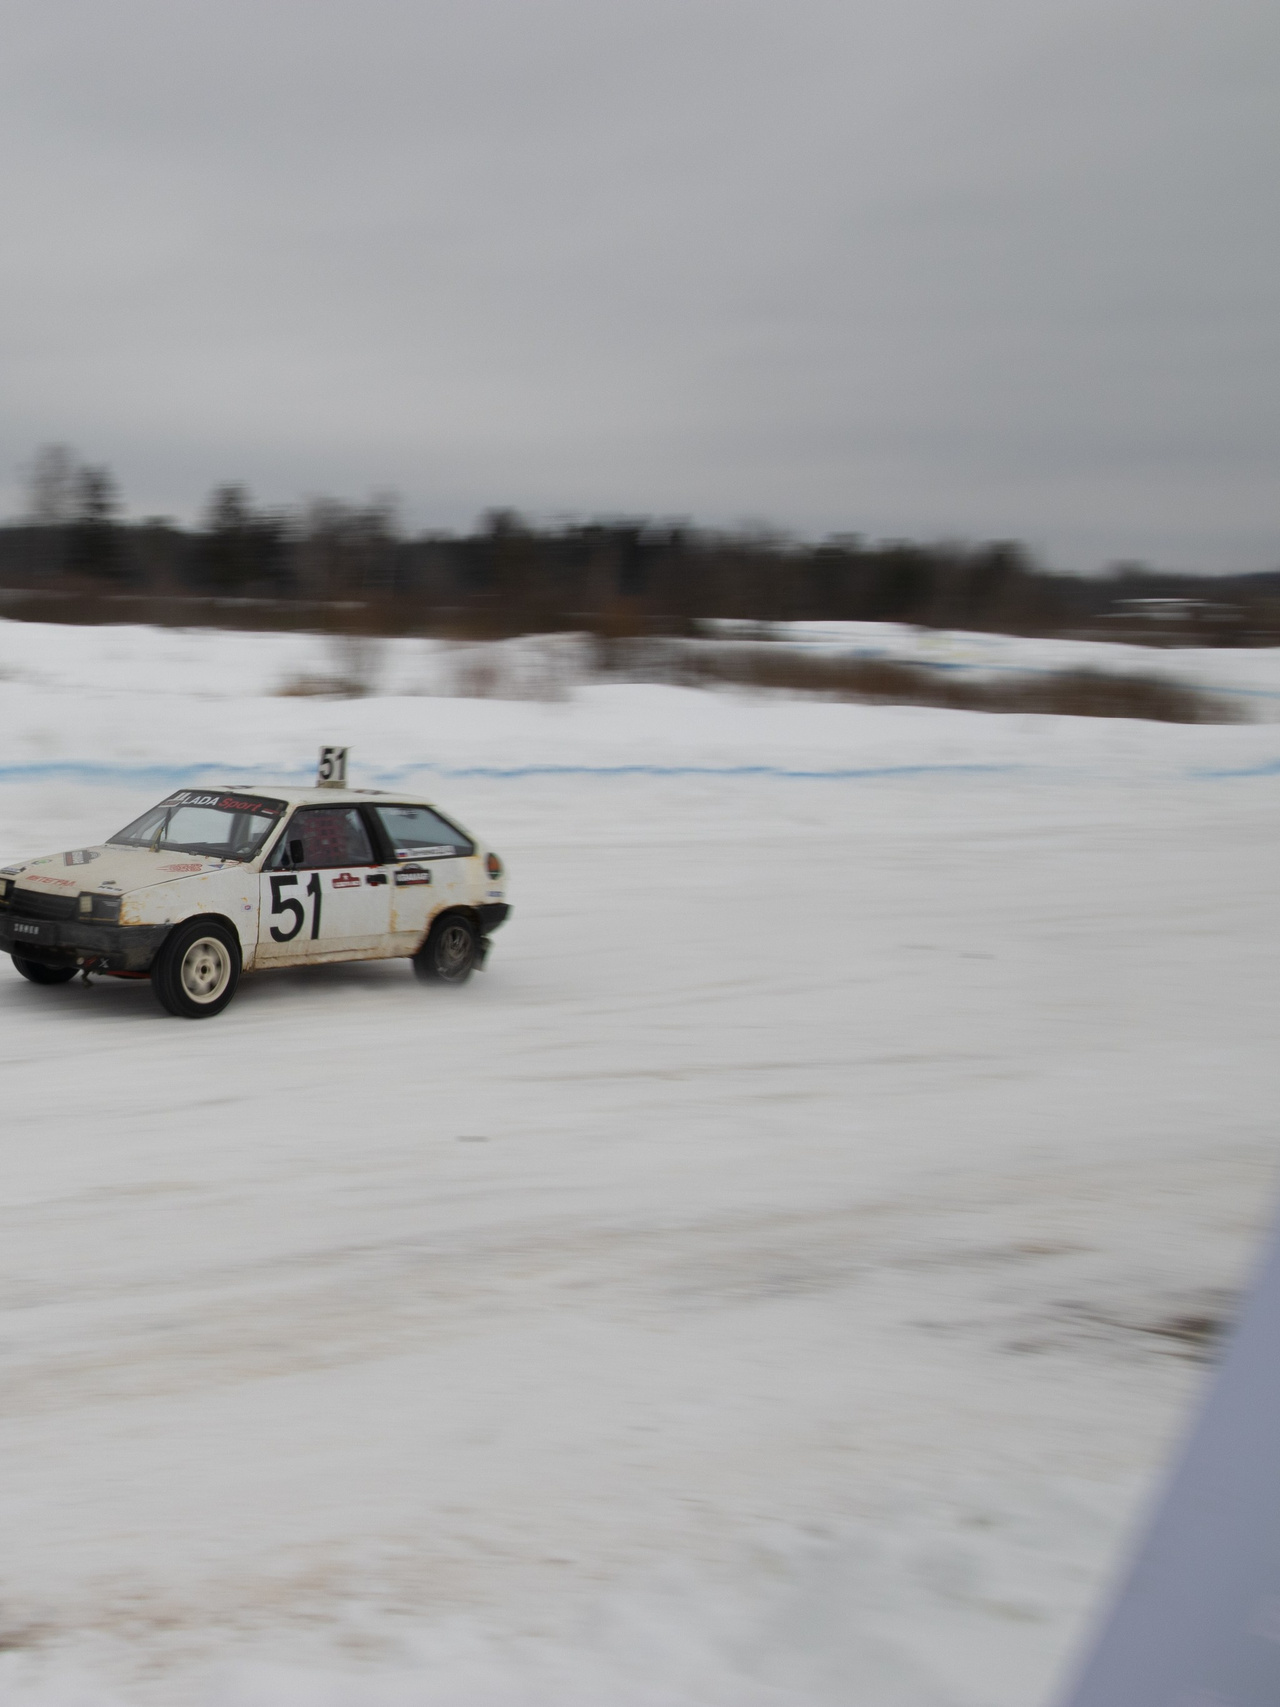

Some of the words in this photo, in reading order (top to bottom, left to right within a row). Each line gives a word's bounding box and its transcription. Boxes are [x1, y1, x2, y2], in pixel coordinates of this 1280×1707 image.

[320, 748, 347, 780] 51
[181, 796, 219, 806] LADA
[219, 798, 262, 812] Sport
[269, 873, 322, 943] 51
